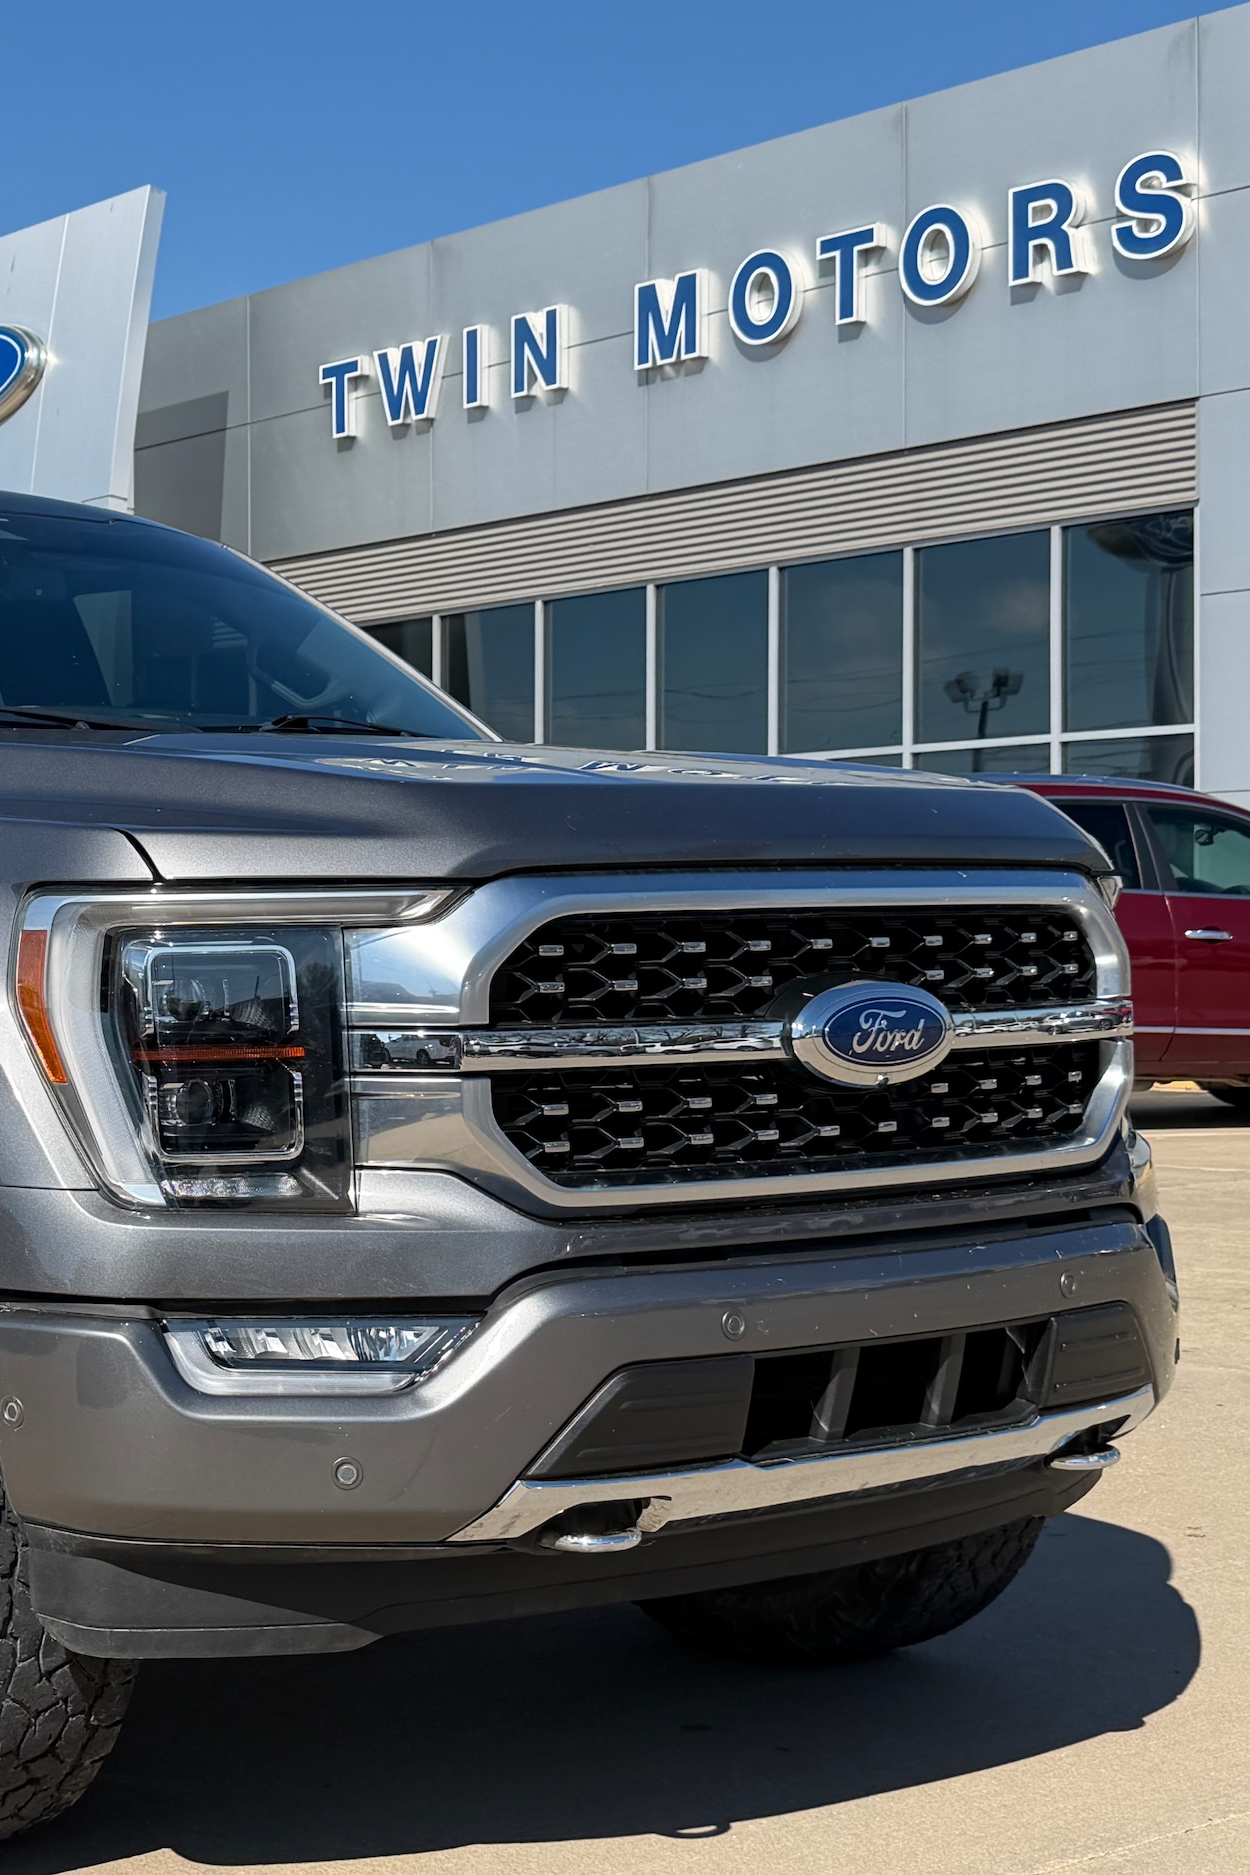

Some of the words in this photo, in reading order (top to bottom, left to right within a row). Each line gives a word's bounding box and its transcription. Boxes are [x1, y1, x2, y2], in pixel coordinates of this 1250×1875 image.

[319, 303, 569, 438] TWIN
[634, 150, 1196, 370] MOTORS
[851, 1009, 925, 1055] Ford
